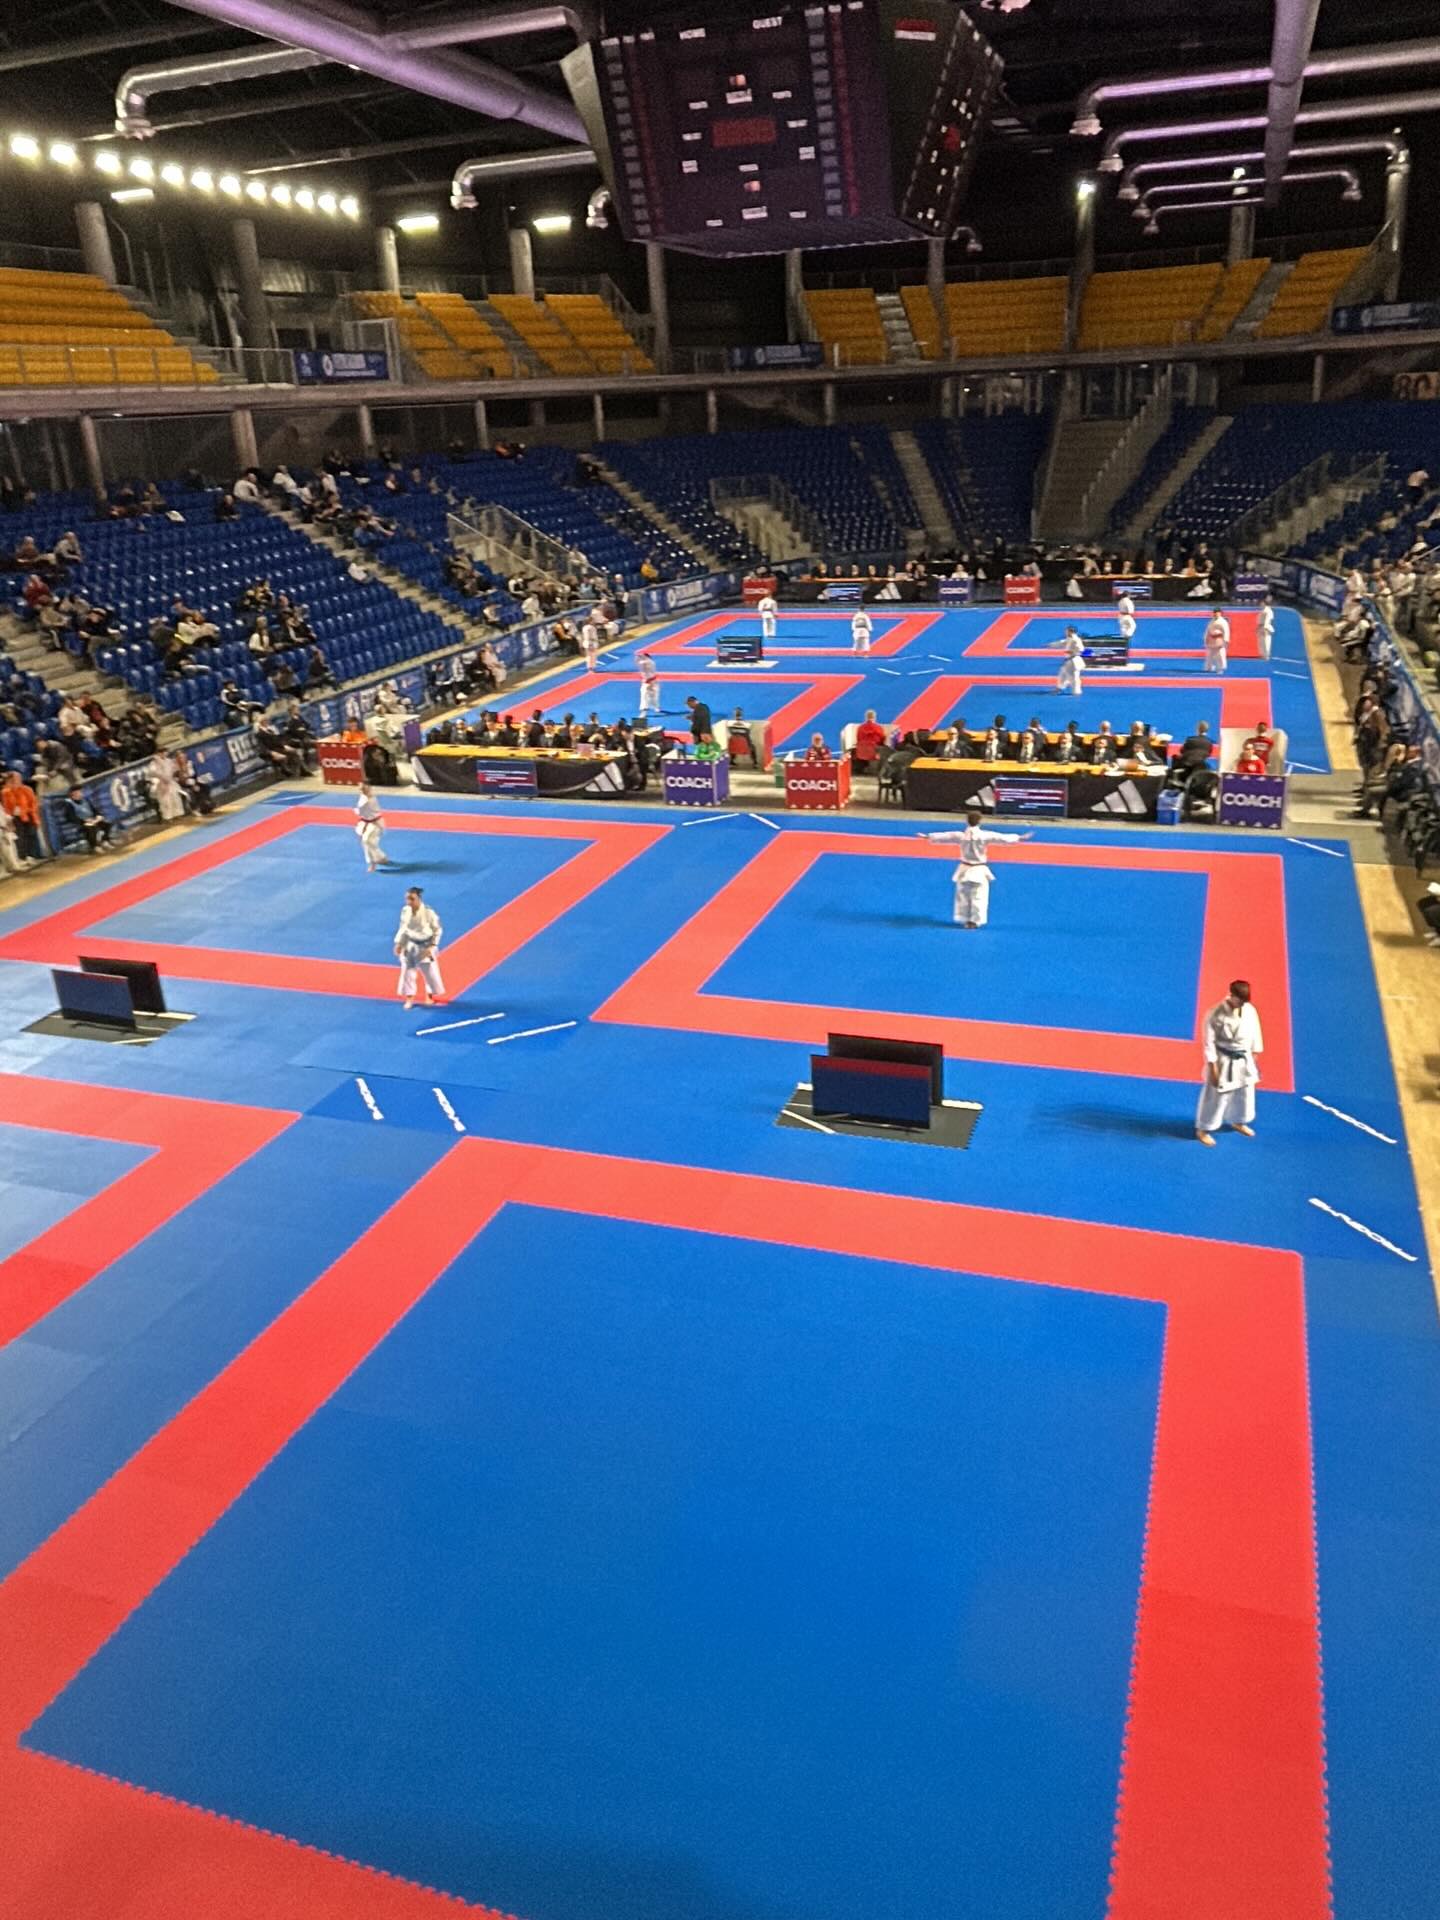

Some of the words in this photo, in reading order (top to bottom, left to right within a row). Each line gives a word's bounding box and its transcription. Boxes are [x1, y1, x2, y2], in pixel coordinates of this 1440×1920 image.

[321, 757, 361, 769] COACH
[666, 775, 713, 789] COACH
[787, 779, 837, 792] COACH
[1222, 792, 1283, 809] COACH
